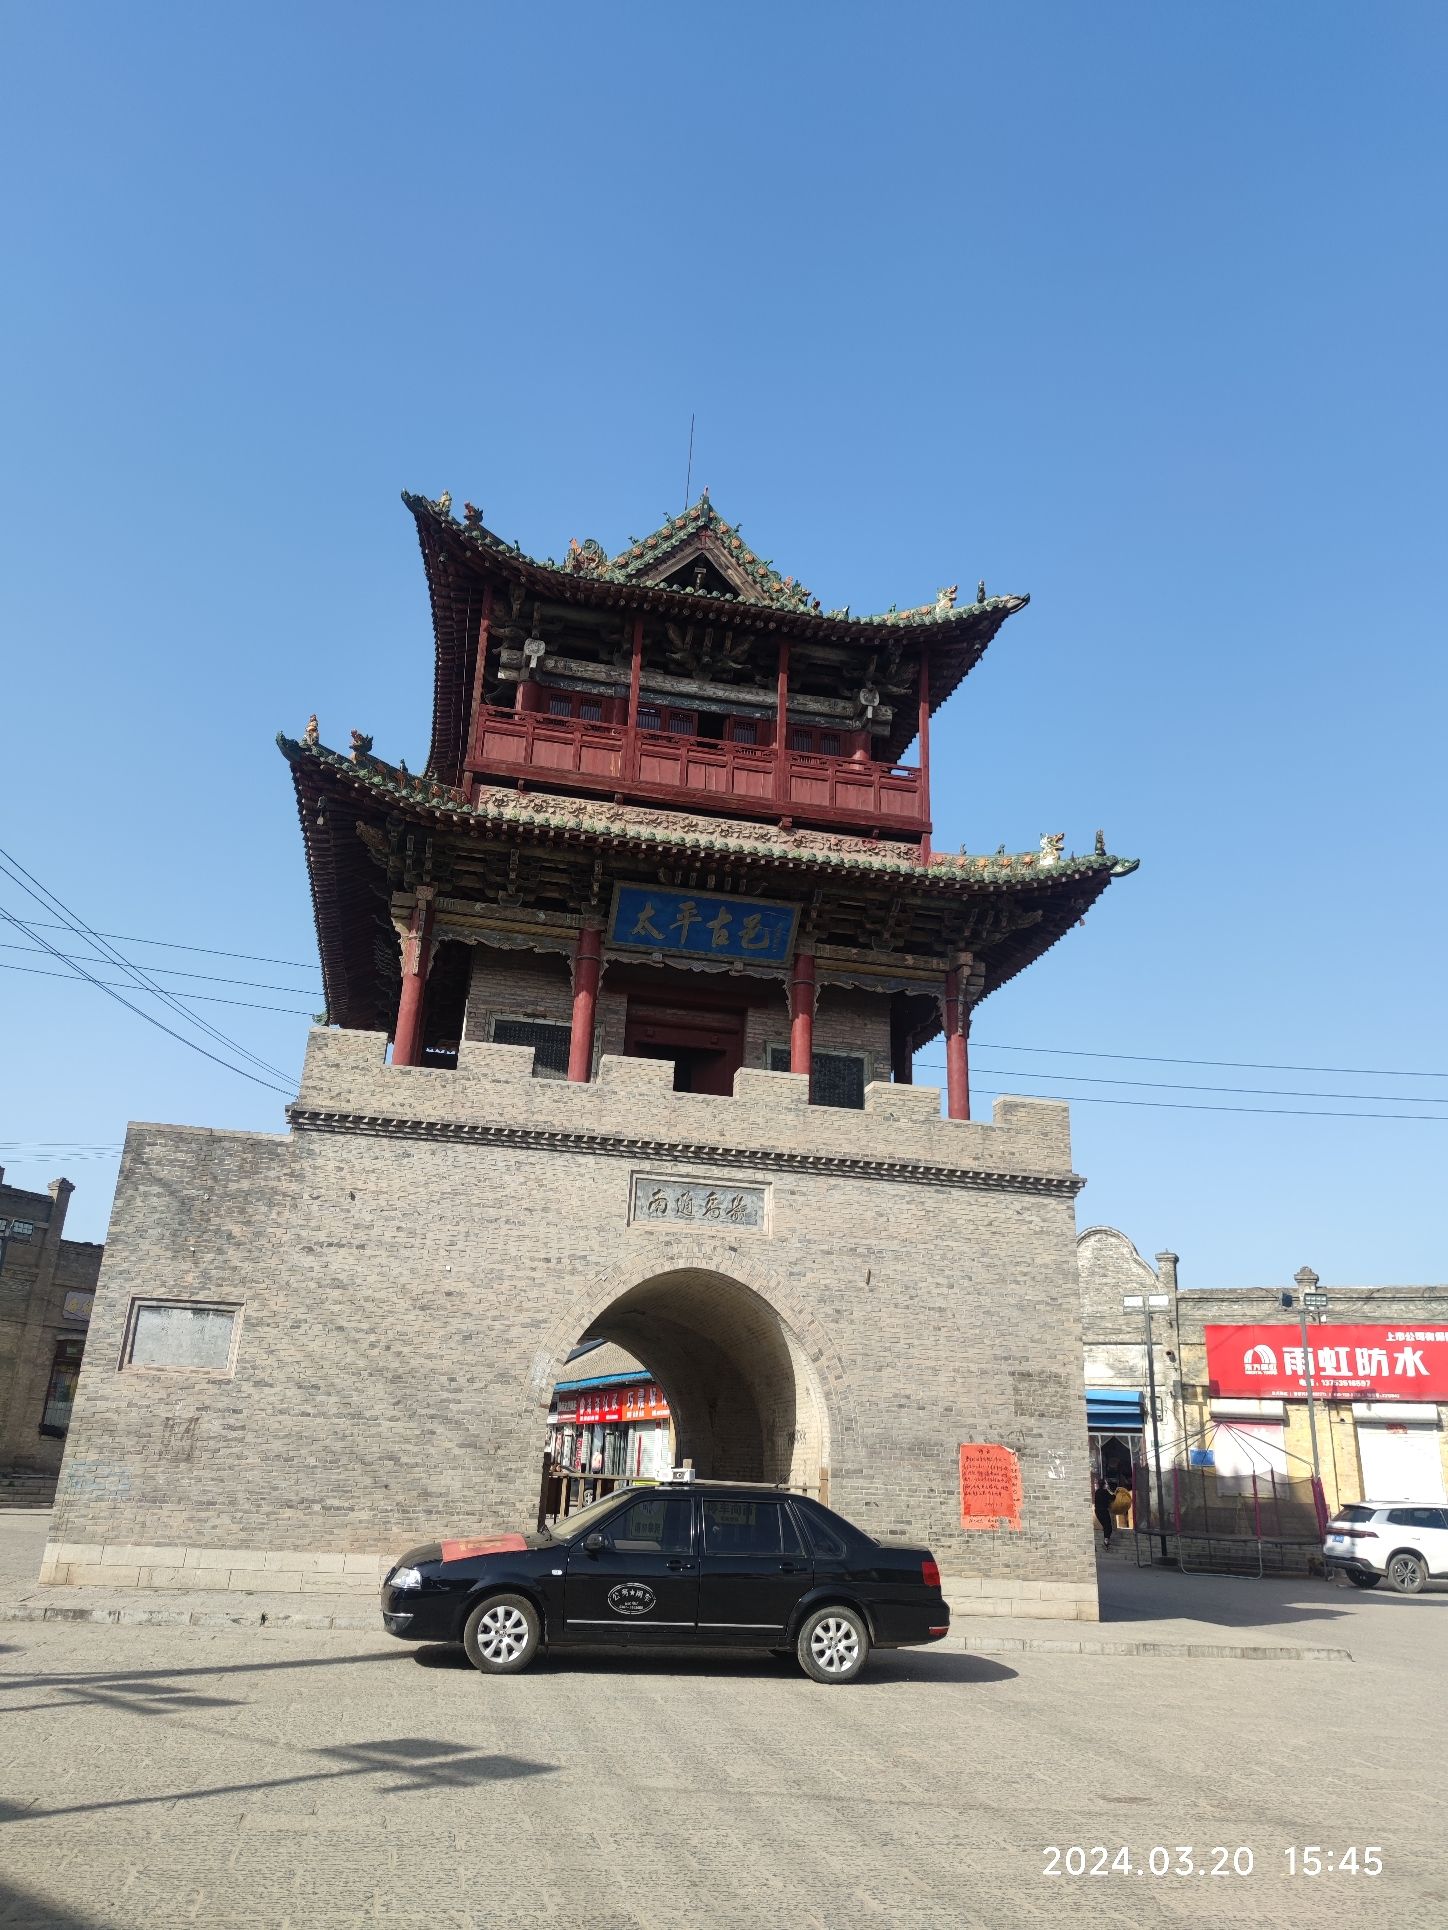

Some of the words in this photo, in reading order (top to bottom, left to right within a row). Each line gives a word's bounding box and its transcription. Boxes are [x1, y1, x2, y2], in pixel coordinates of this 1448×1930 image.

[631, 901, 770, 950] 太平古邑
[1282, 1346, 1430, 1376] 雨虹防水
